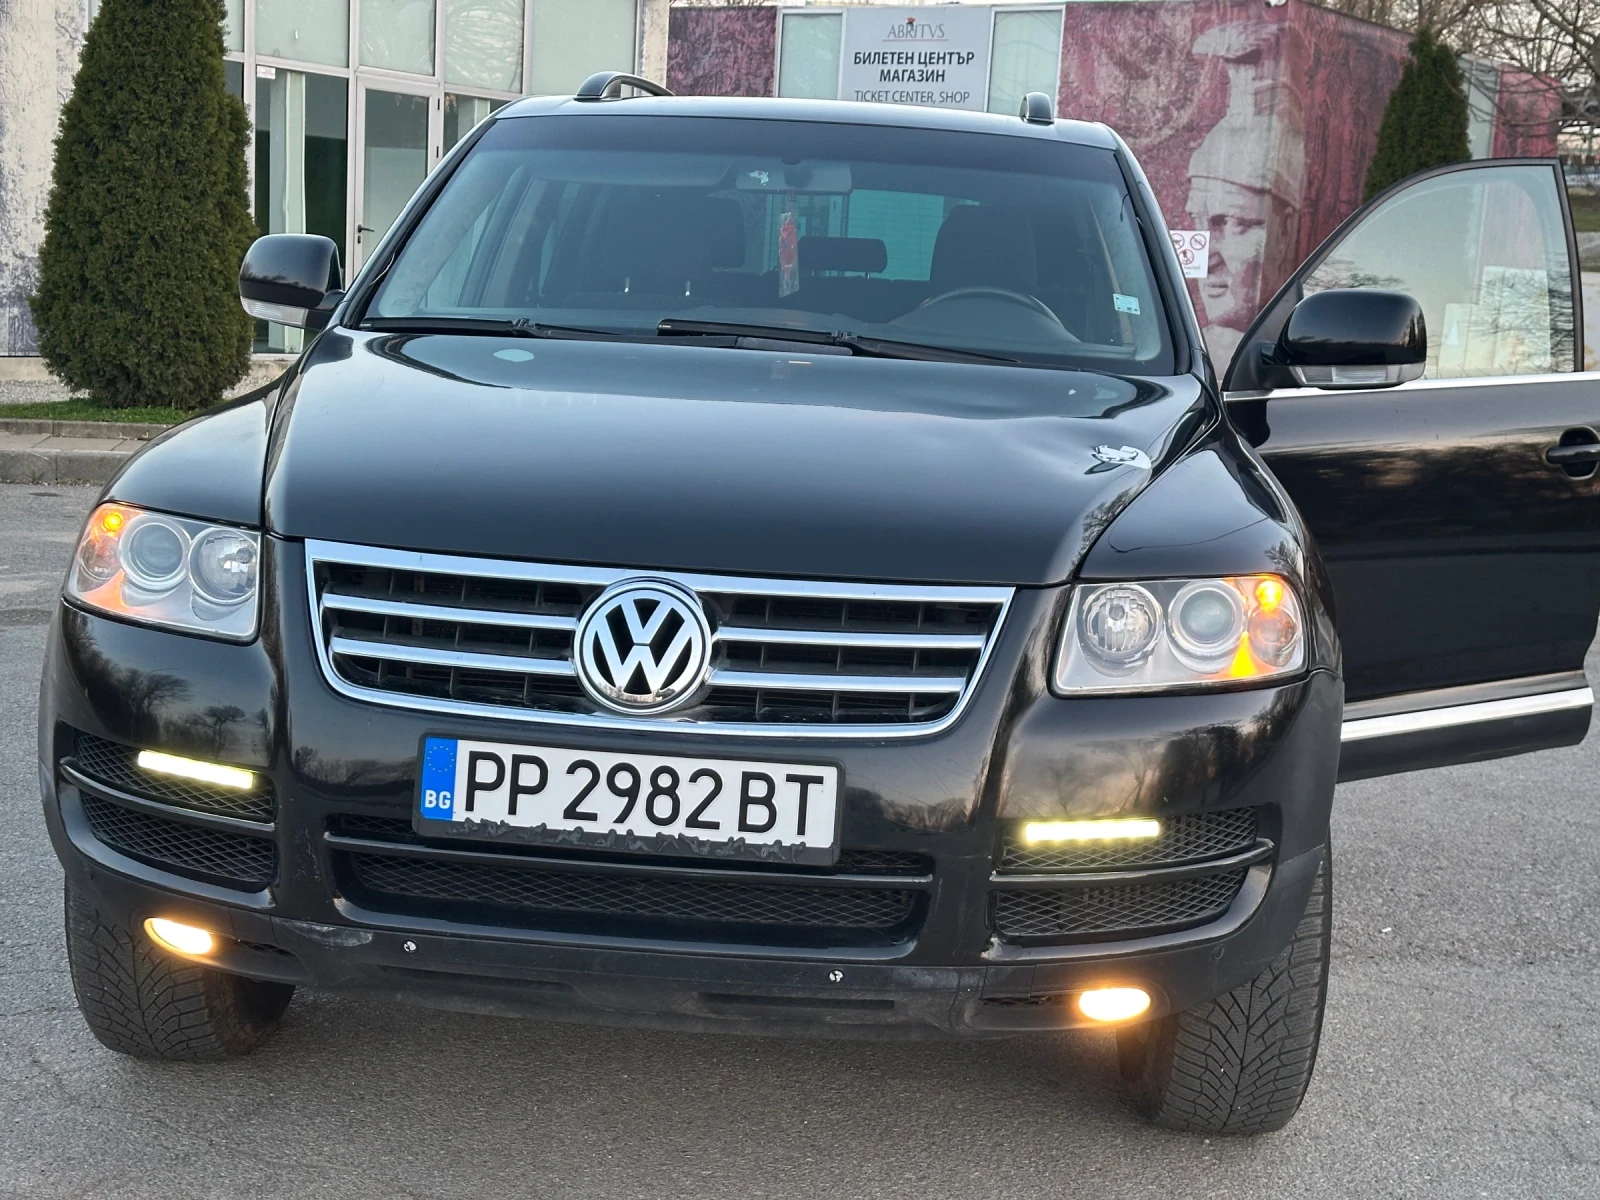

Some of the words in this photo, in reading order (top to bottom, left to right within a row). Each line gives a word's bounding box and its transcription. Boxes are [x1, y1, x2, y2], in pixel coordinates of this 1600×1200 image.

[854, 51, 914, 65] БИЛЕТЕН
[918, 52, 975, 67] ЦЕНТЪР
[879, 69, 946, 82] МАГАЗИН
[855, 90, 890, 103] TICKET
[892, 90, 936, 104] CENTER,
[939, 91, 970, 104] SHOP
[424, 789, 451, 809] BG
[465, 750, 549, 815] PP
[563, 759, 723, 830] 2982
[738, 771, 824, 836] BT
